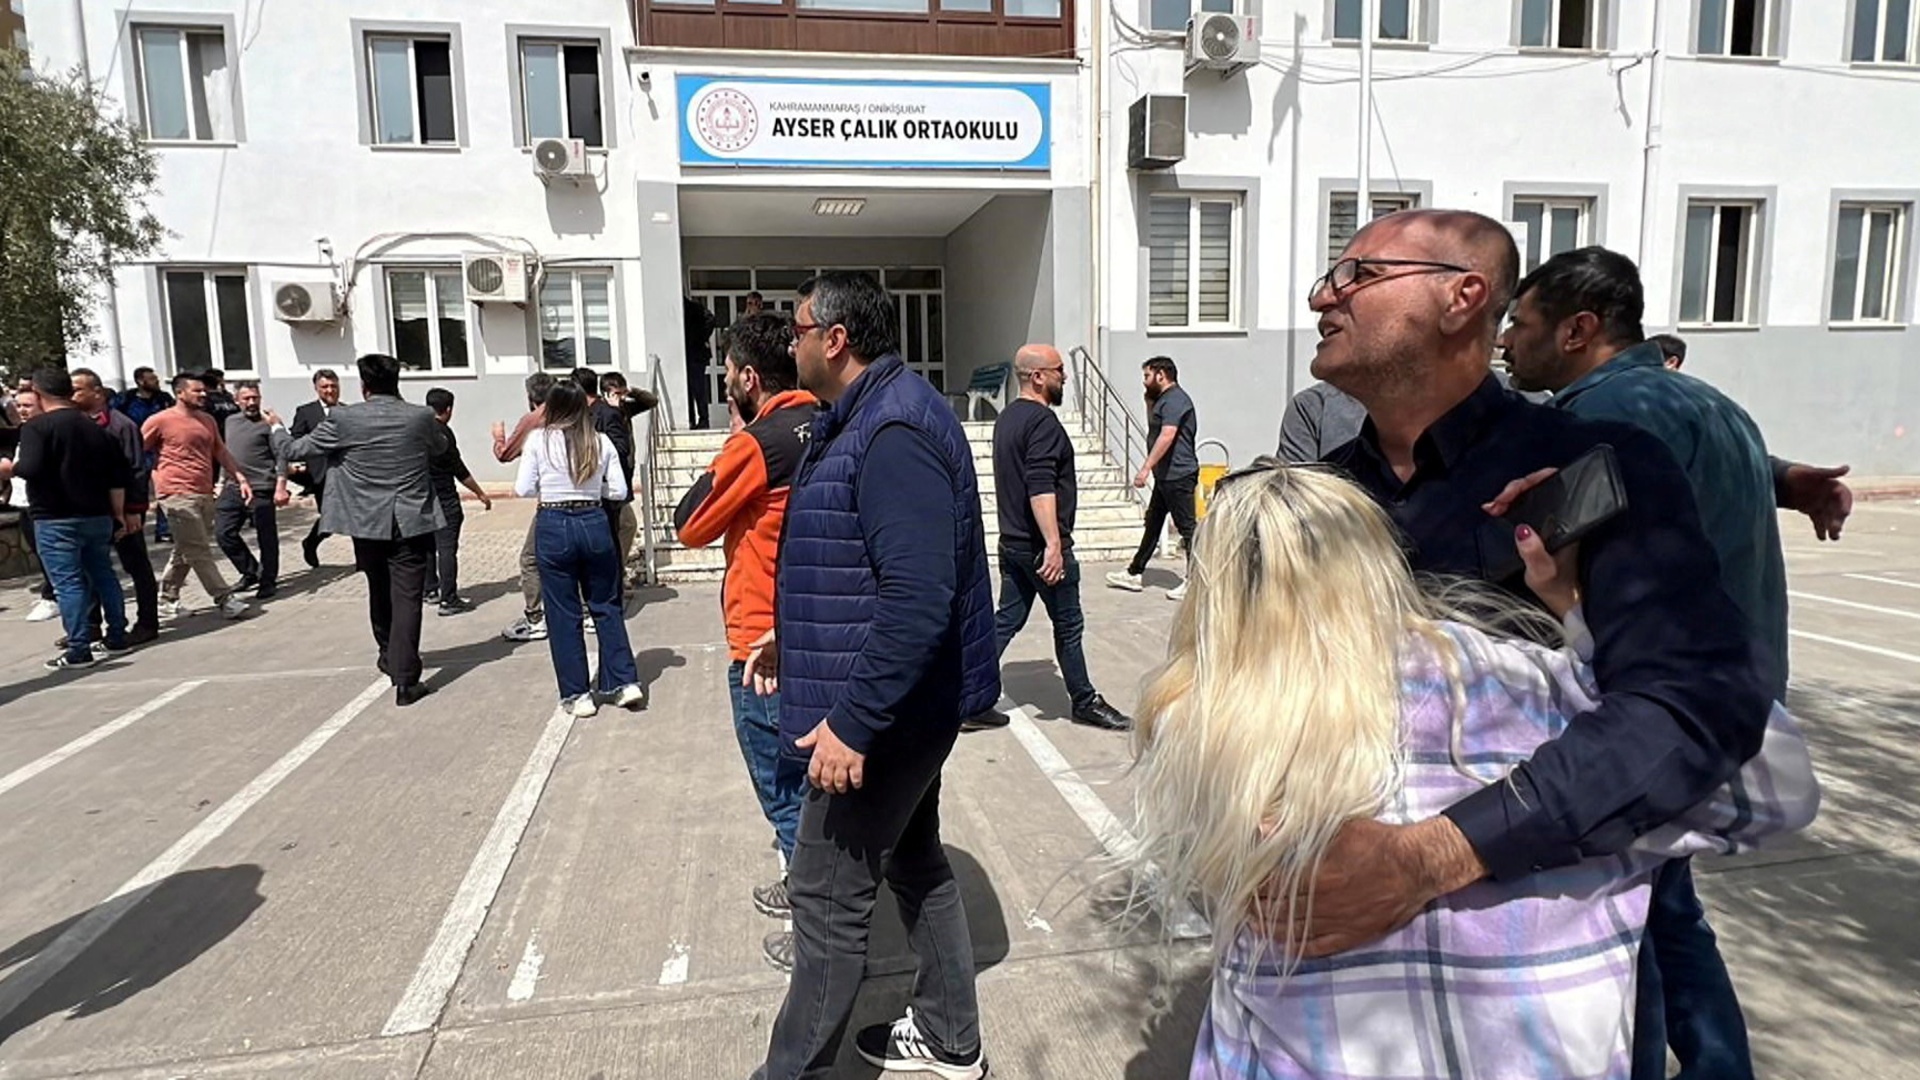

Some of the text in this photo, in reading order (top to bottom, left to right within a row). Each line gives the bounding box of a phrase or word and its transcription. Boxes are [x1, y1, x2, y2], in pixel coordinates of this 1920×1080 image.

[769, 102, 861, 115] KAHRAMANMARAŞ
[772, 117, 835, 138] AYSER
[840, 119, 898, 142] ÇALIK
[903, 120, 1018, 140] ORTAOKULU
